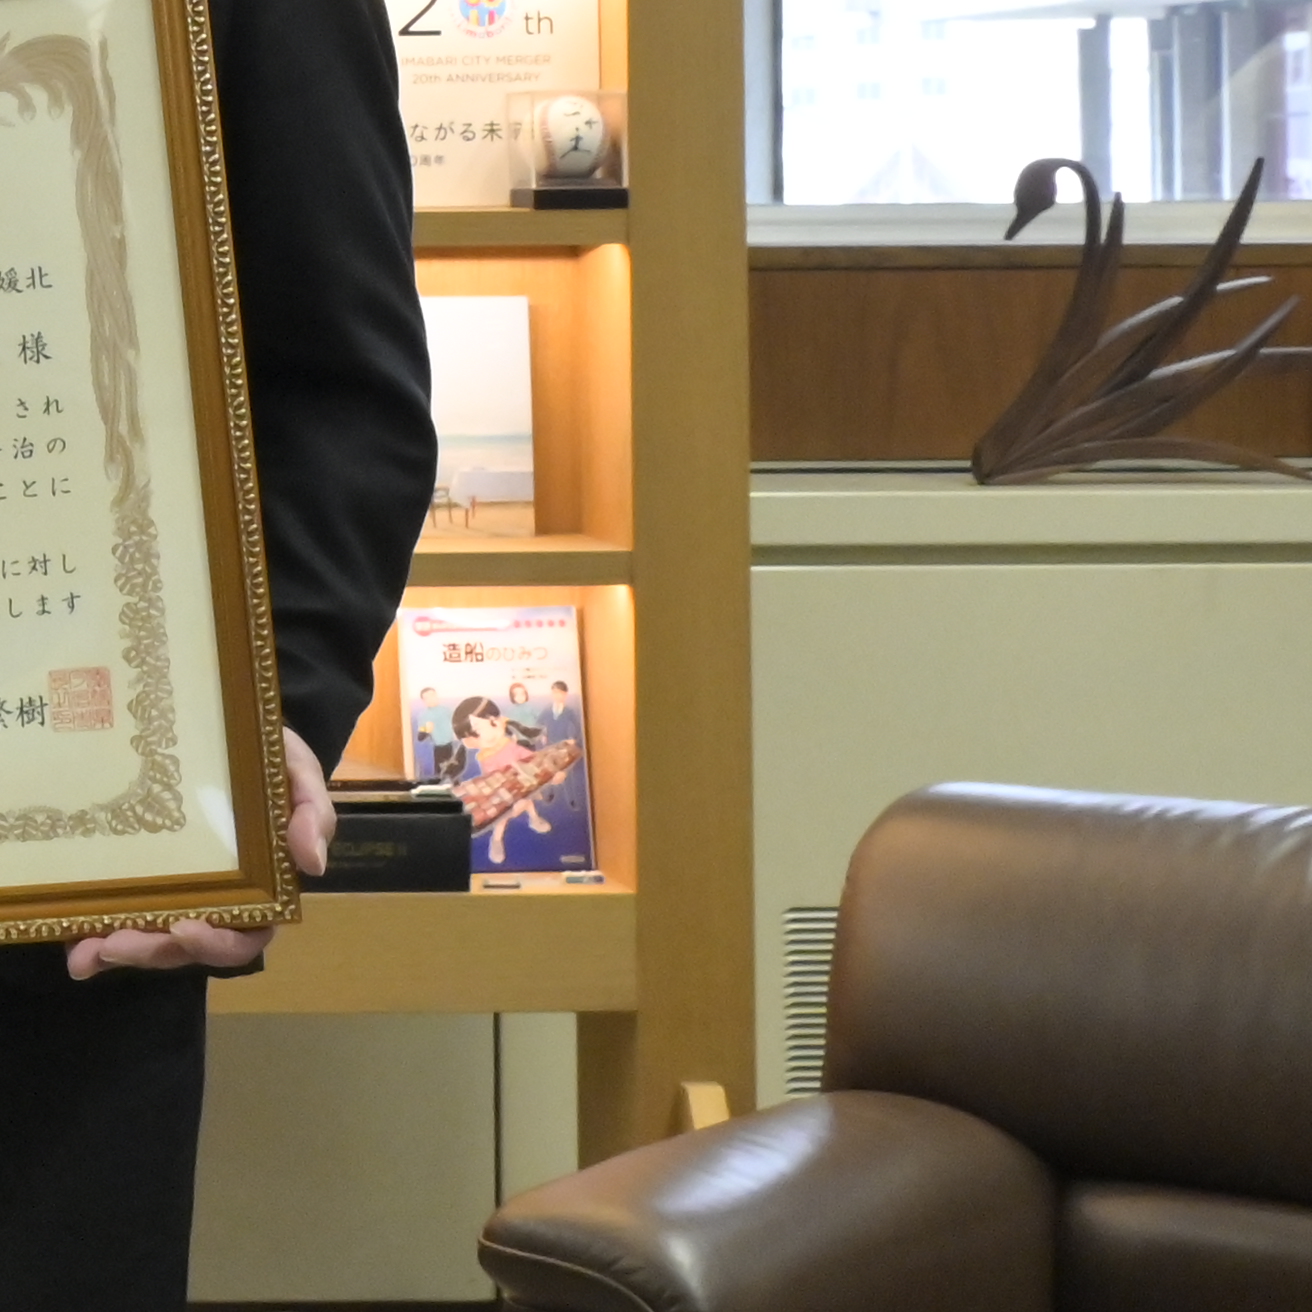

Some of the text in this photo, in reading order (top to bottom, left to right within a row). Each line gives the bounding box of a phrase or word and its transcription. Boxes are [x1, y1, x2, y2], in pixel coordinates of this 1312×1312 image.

[524, 11, 554, 35] th
[401, 54, 551, 67] IMABARI CITY MERGER
[412, 72, 541, 84] 20th ANNIVERSARY
[18, 332, 54, 364] 様
[442, 641, 548, 664] 造船のひみつ
